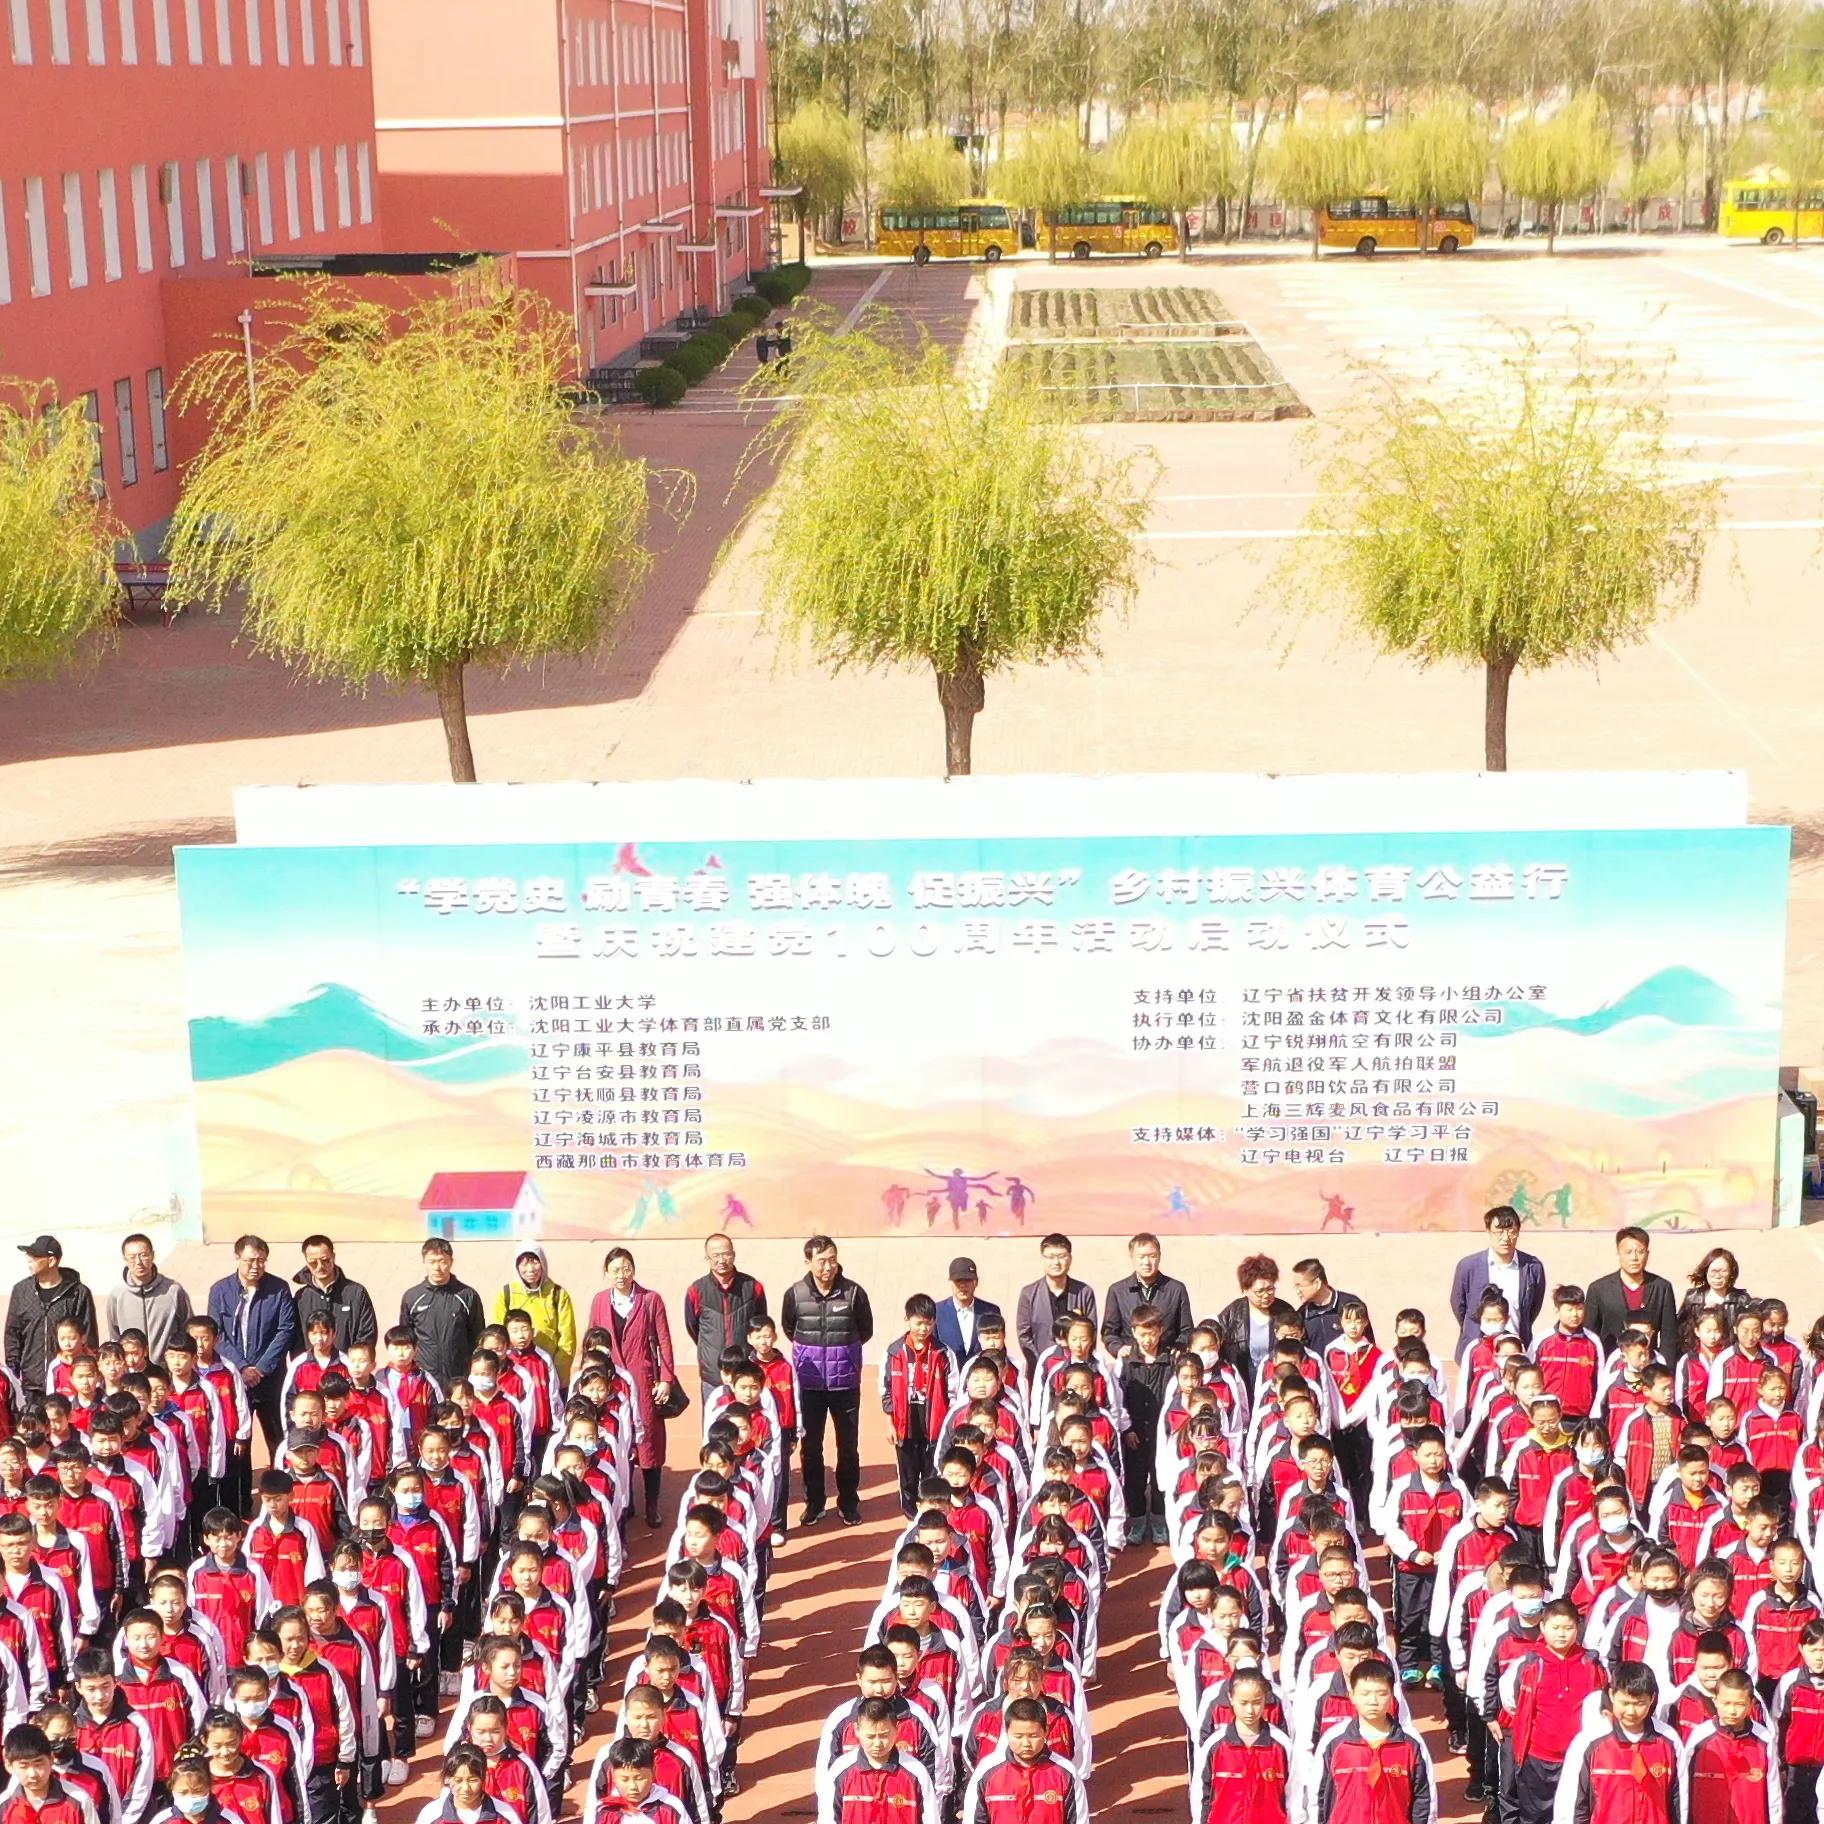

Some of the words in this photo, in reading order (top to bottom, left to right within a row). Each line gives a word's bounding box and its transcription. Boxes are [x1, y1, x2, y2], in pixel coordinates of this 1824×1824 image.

[1109, 863, 1568, 904] 乡村振兴体育公益行
[529, 994, 656, 1010] 沈阳工业大学
[1242, 985, 1547, 1003] 辽宁省扶贫开发领导小组办公室
[530, 1015, 831, 1034] 沈阳工业大学体育部直属党支部
[1242, 1008, 1503, 1026] 沈阳盈金体育文化有限公司
[1242, 1031, 1458, 1050] 辽宁锐翔航空有限公司
[530, 1041, 701, 1059] 辽宁康平县教育局
[532, 1064, 702, 1080] 辽宁台安县教育局
[1241, 1055, 1457, 1072] 军航退役军人航拍联盟
[532, 1086, 702, 1103] 辽宁抚顺县教育局
[534, 1108, 703, 1125] 辽宁凌源市教育局
[535, 1131, 704, 1147] 辽宁海城市教育局
[535, 1152, 747, 1169] 西藏那曲市教育体育局
[1241, 1147, 1346, 1164] 辽宁电视台
[1385, 1146, 1468, 1163] 辽宁日报
